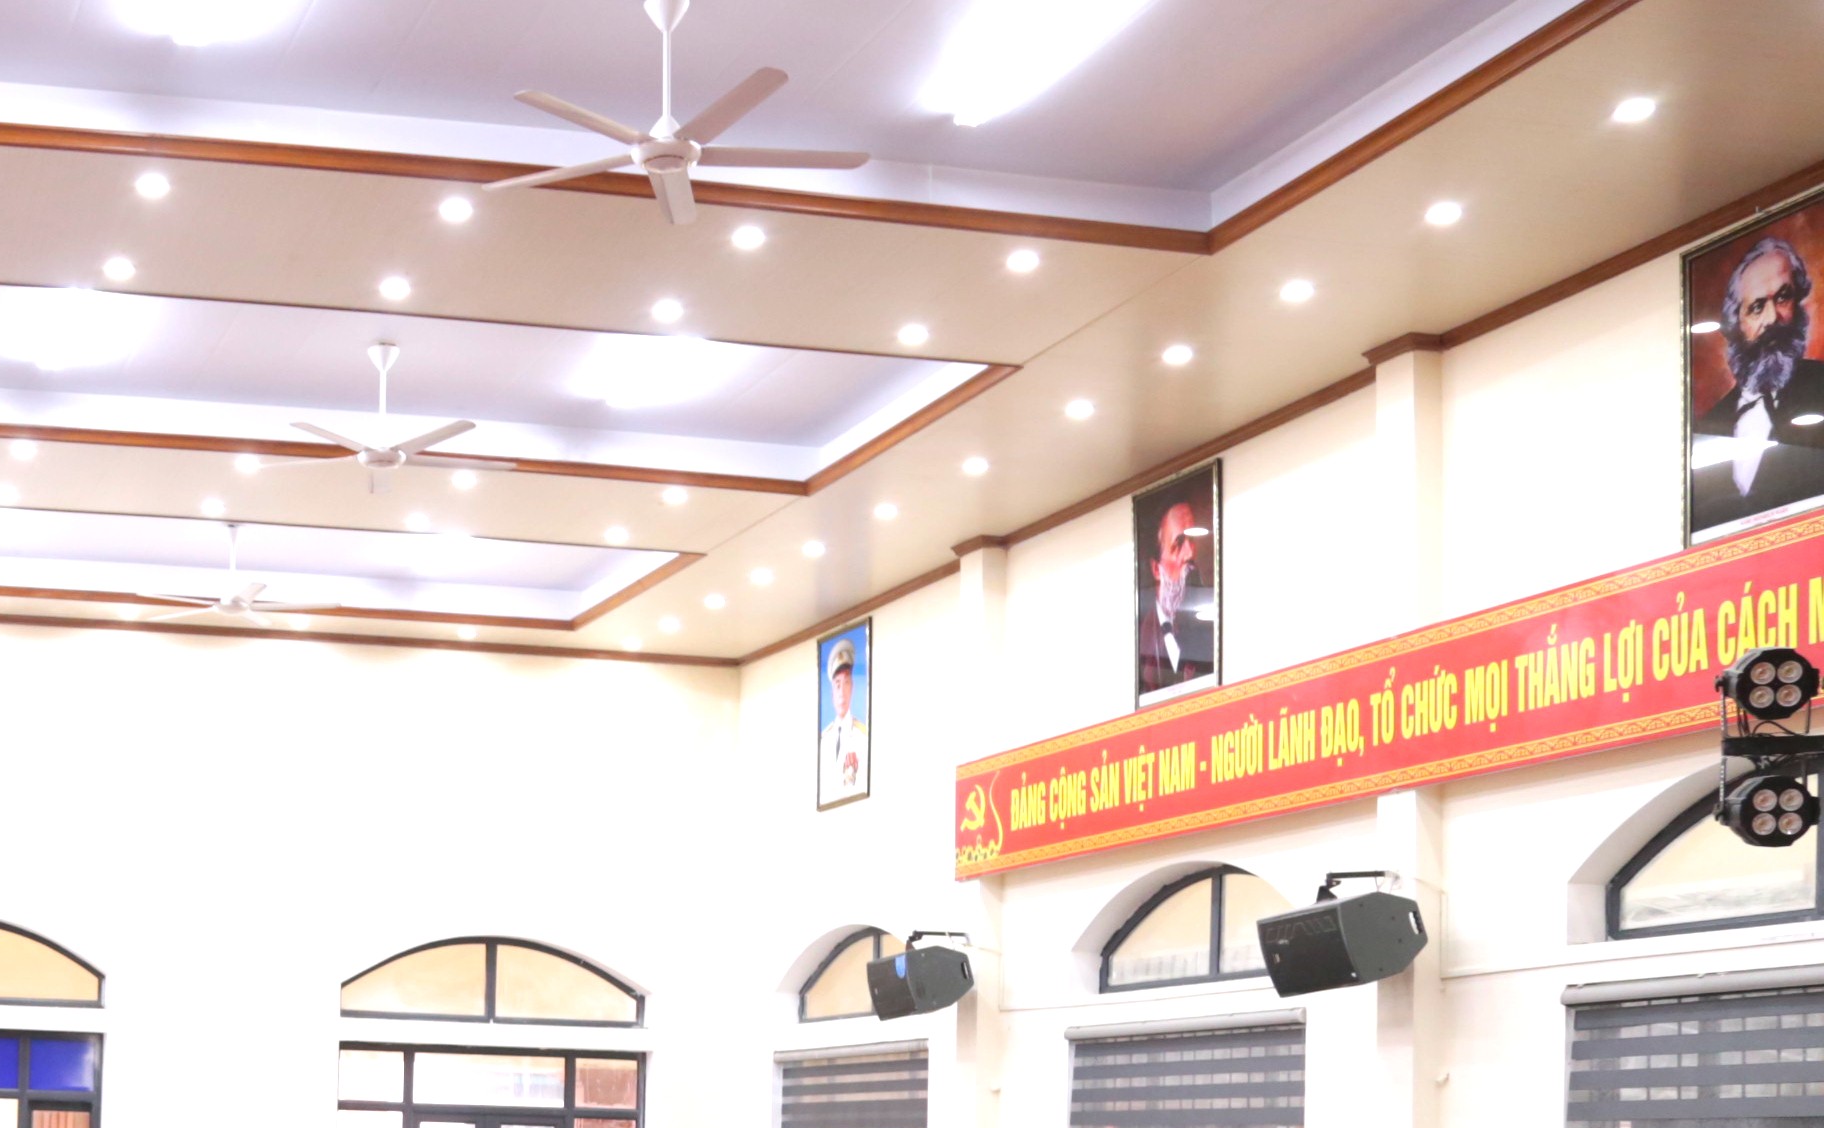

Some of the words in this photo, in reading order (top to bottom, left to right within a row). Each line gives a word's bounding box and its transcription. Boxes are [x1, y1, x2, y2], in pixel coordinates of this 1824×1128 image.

[1050, 767, 1086, 830] CỘNG
[1090, 749, 1120, 812] SẢN
[1123, 745, 1155, 812] VIỆT
[1159, 742, 1195, 797] NAM
[1211, 714, 1263, 784] NGƯỜI
[1268, 707, 1315, 770] LÃNH
[1321, 698, 1364, 767] ĐẠO,
[1370, 666, 1396, 746] TỔ
[1401, 664, 1457, 739] CHỨC
[1464, 659, 1508, 732] MỌI
[1515, 623, 1595, 713] THẮNG
[1603, 619, 1644, 703] LỢI
[1652, 591, 1709, 681] CỦA
[1717, 581, 1798, 666] CÁCH
